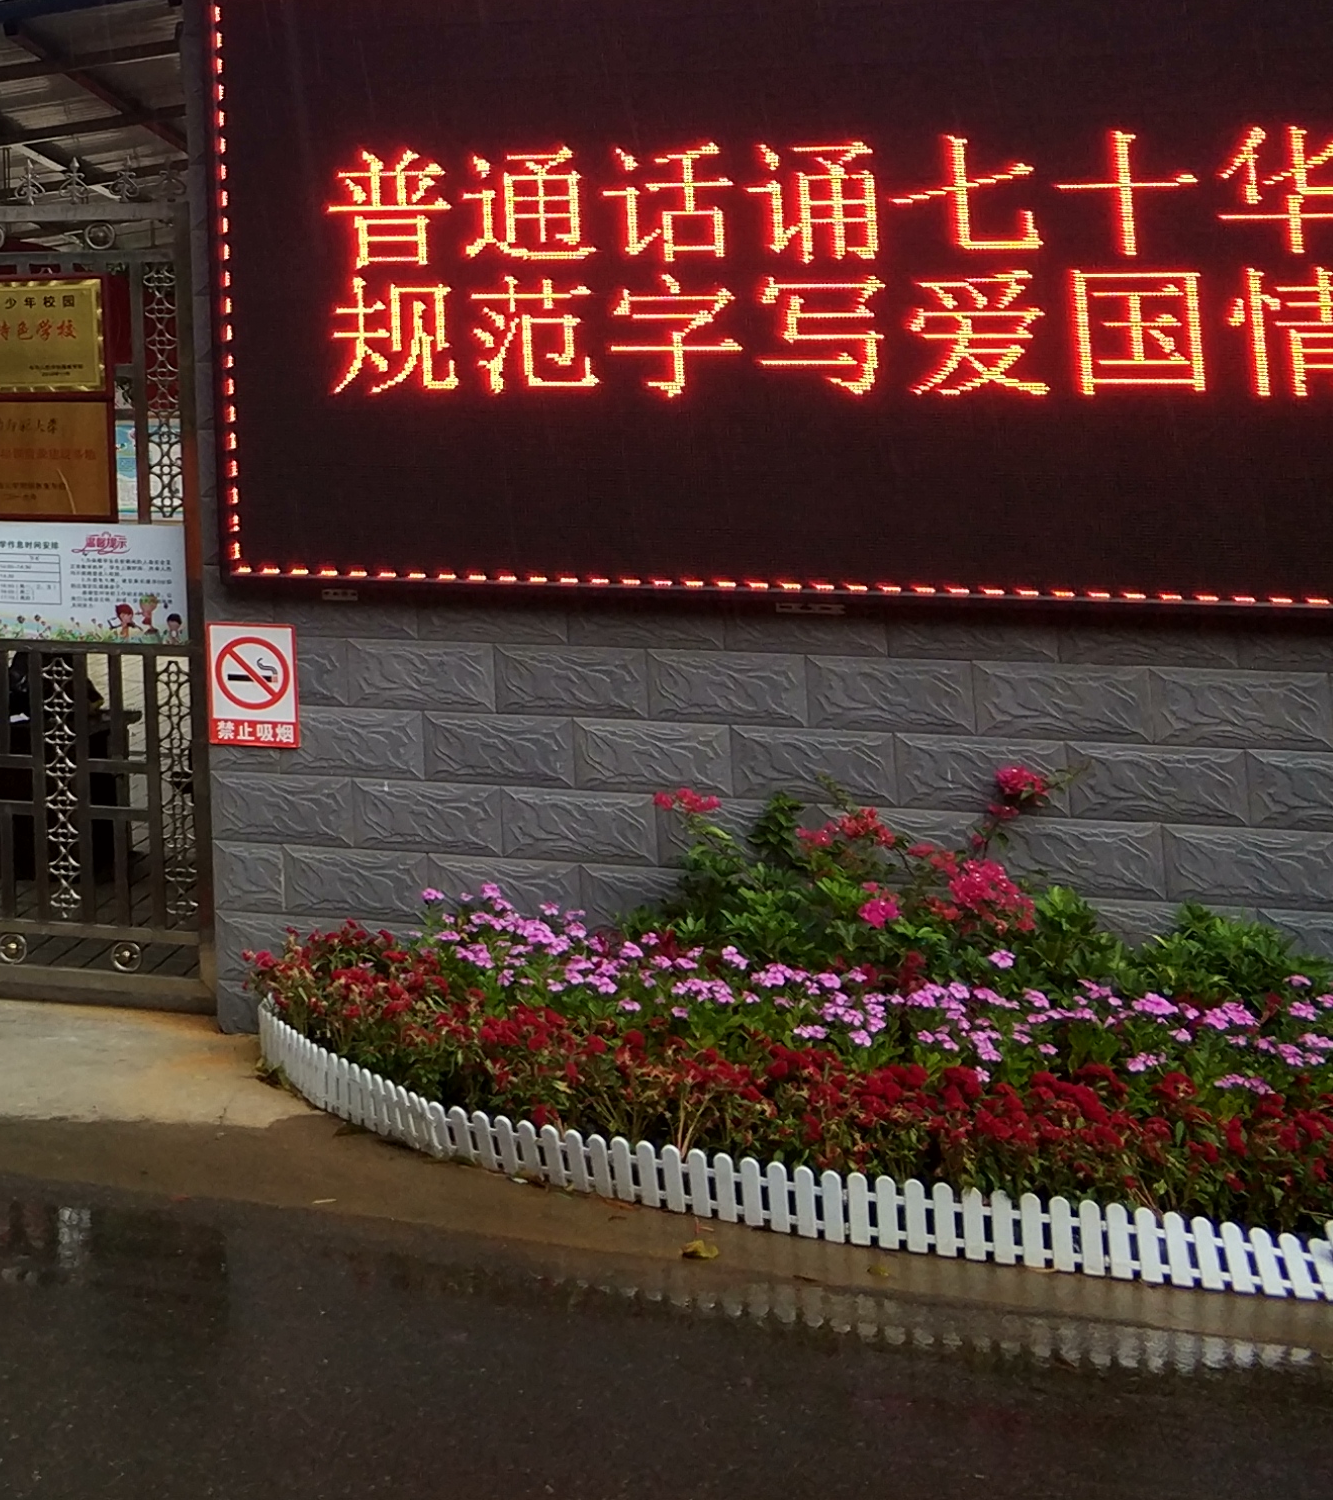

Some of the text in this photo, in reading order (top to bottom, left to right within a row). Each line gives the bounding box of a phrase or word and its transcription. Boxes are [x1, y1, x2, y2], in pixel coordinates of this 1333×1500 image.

[85, 537, 128, 549] 温馨提示
[217, 721, 295, 744] 禁止吸烟
